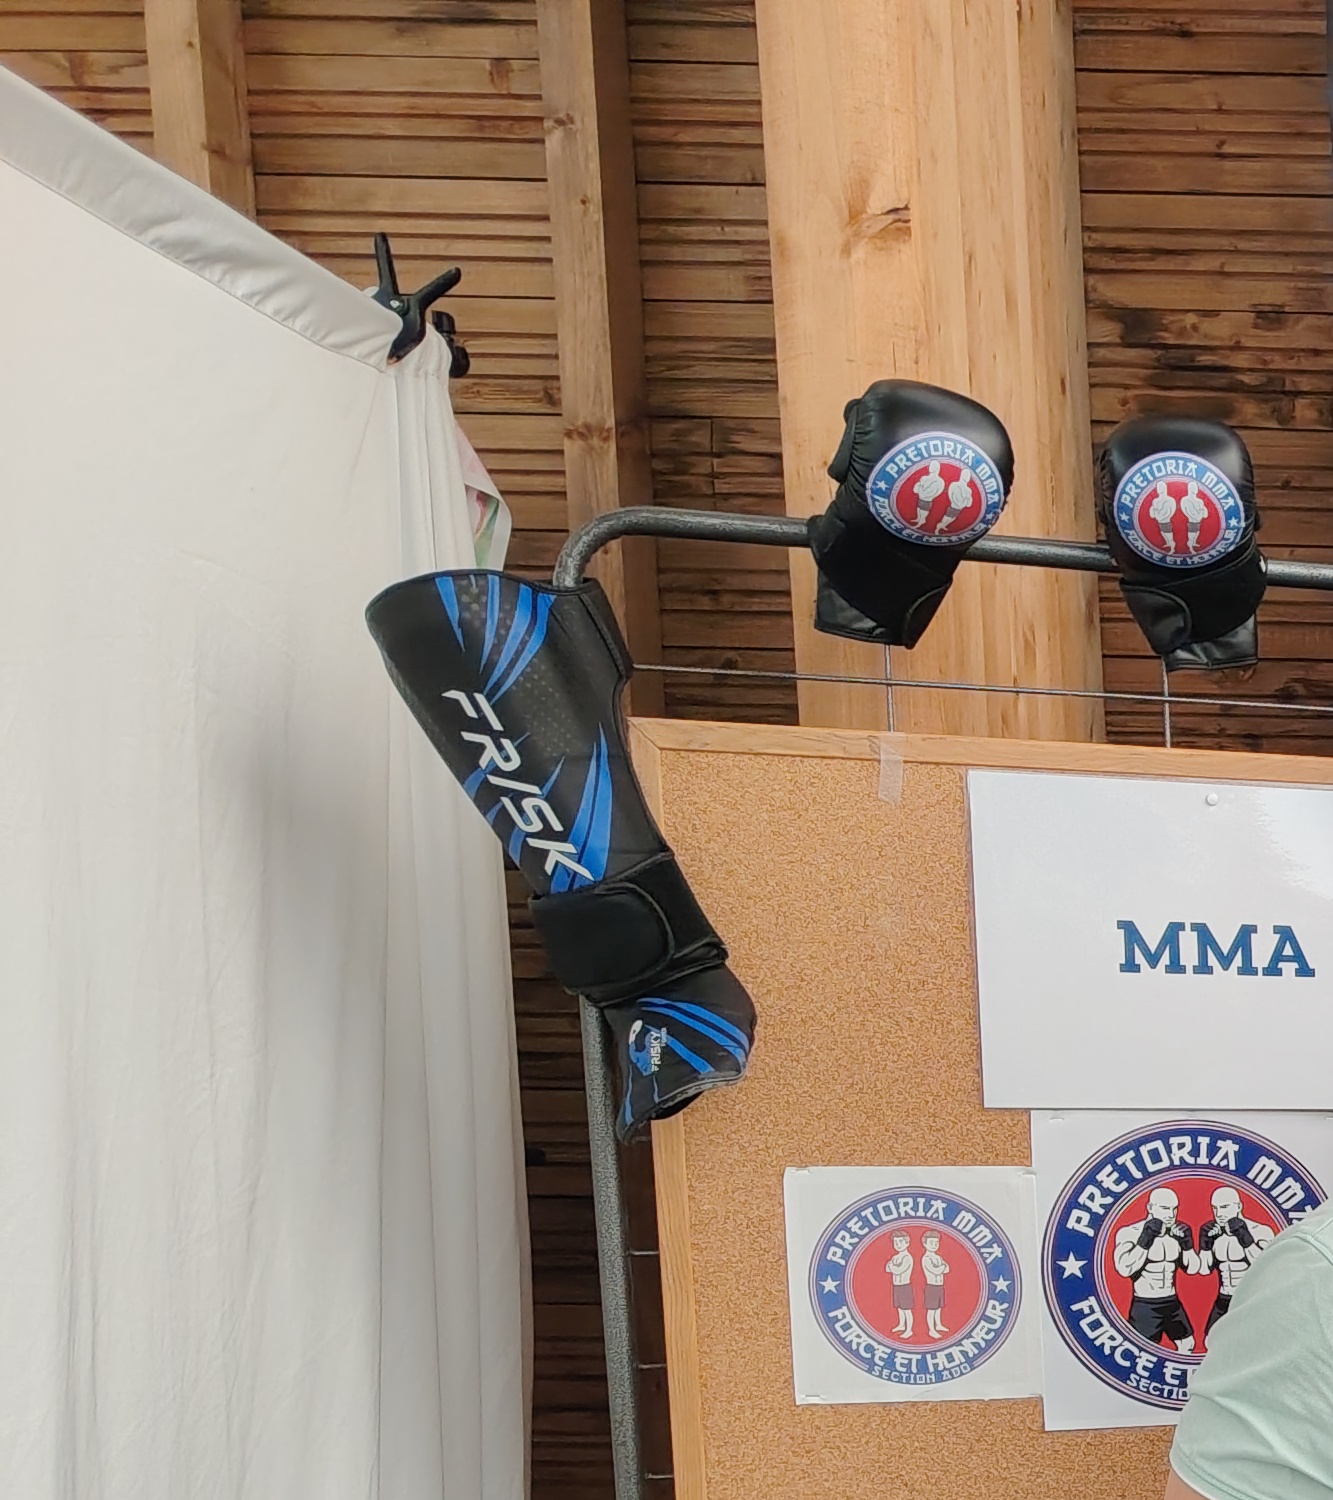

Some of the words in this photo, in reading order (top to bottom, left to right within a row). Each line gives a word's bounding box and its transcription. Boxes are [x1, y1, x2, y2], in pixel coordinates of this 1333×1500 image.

[885, 440, 976, 479] PRETORIA
[975, 463, 1000, 505] MMA
[1121, 459, 1198, 508] PRETORIA
[1202, 471, 1235, 511] MMA
[1117, 920, 1316, 978] MMA
[1064, 1135, 1241, 1237] PRETORIA
[825, 1197, 948, 1267] PRETORIA
[952, 1206, 1003, 1266] MMA
[828, 1305, 886, 1367] FORCE
[893, 1352, 922, 1372] ET
[926, 1299, 1009, 1371] HONNEUR
[1069, 1294, 1158, 1377] FORCE
[871, 1363, 935, 1384] SECTION
[940, 1362, 971, 1381] ADO
